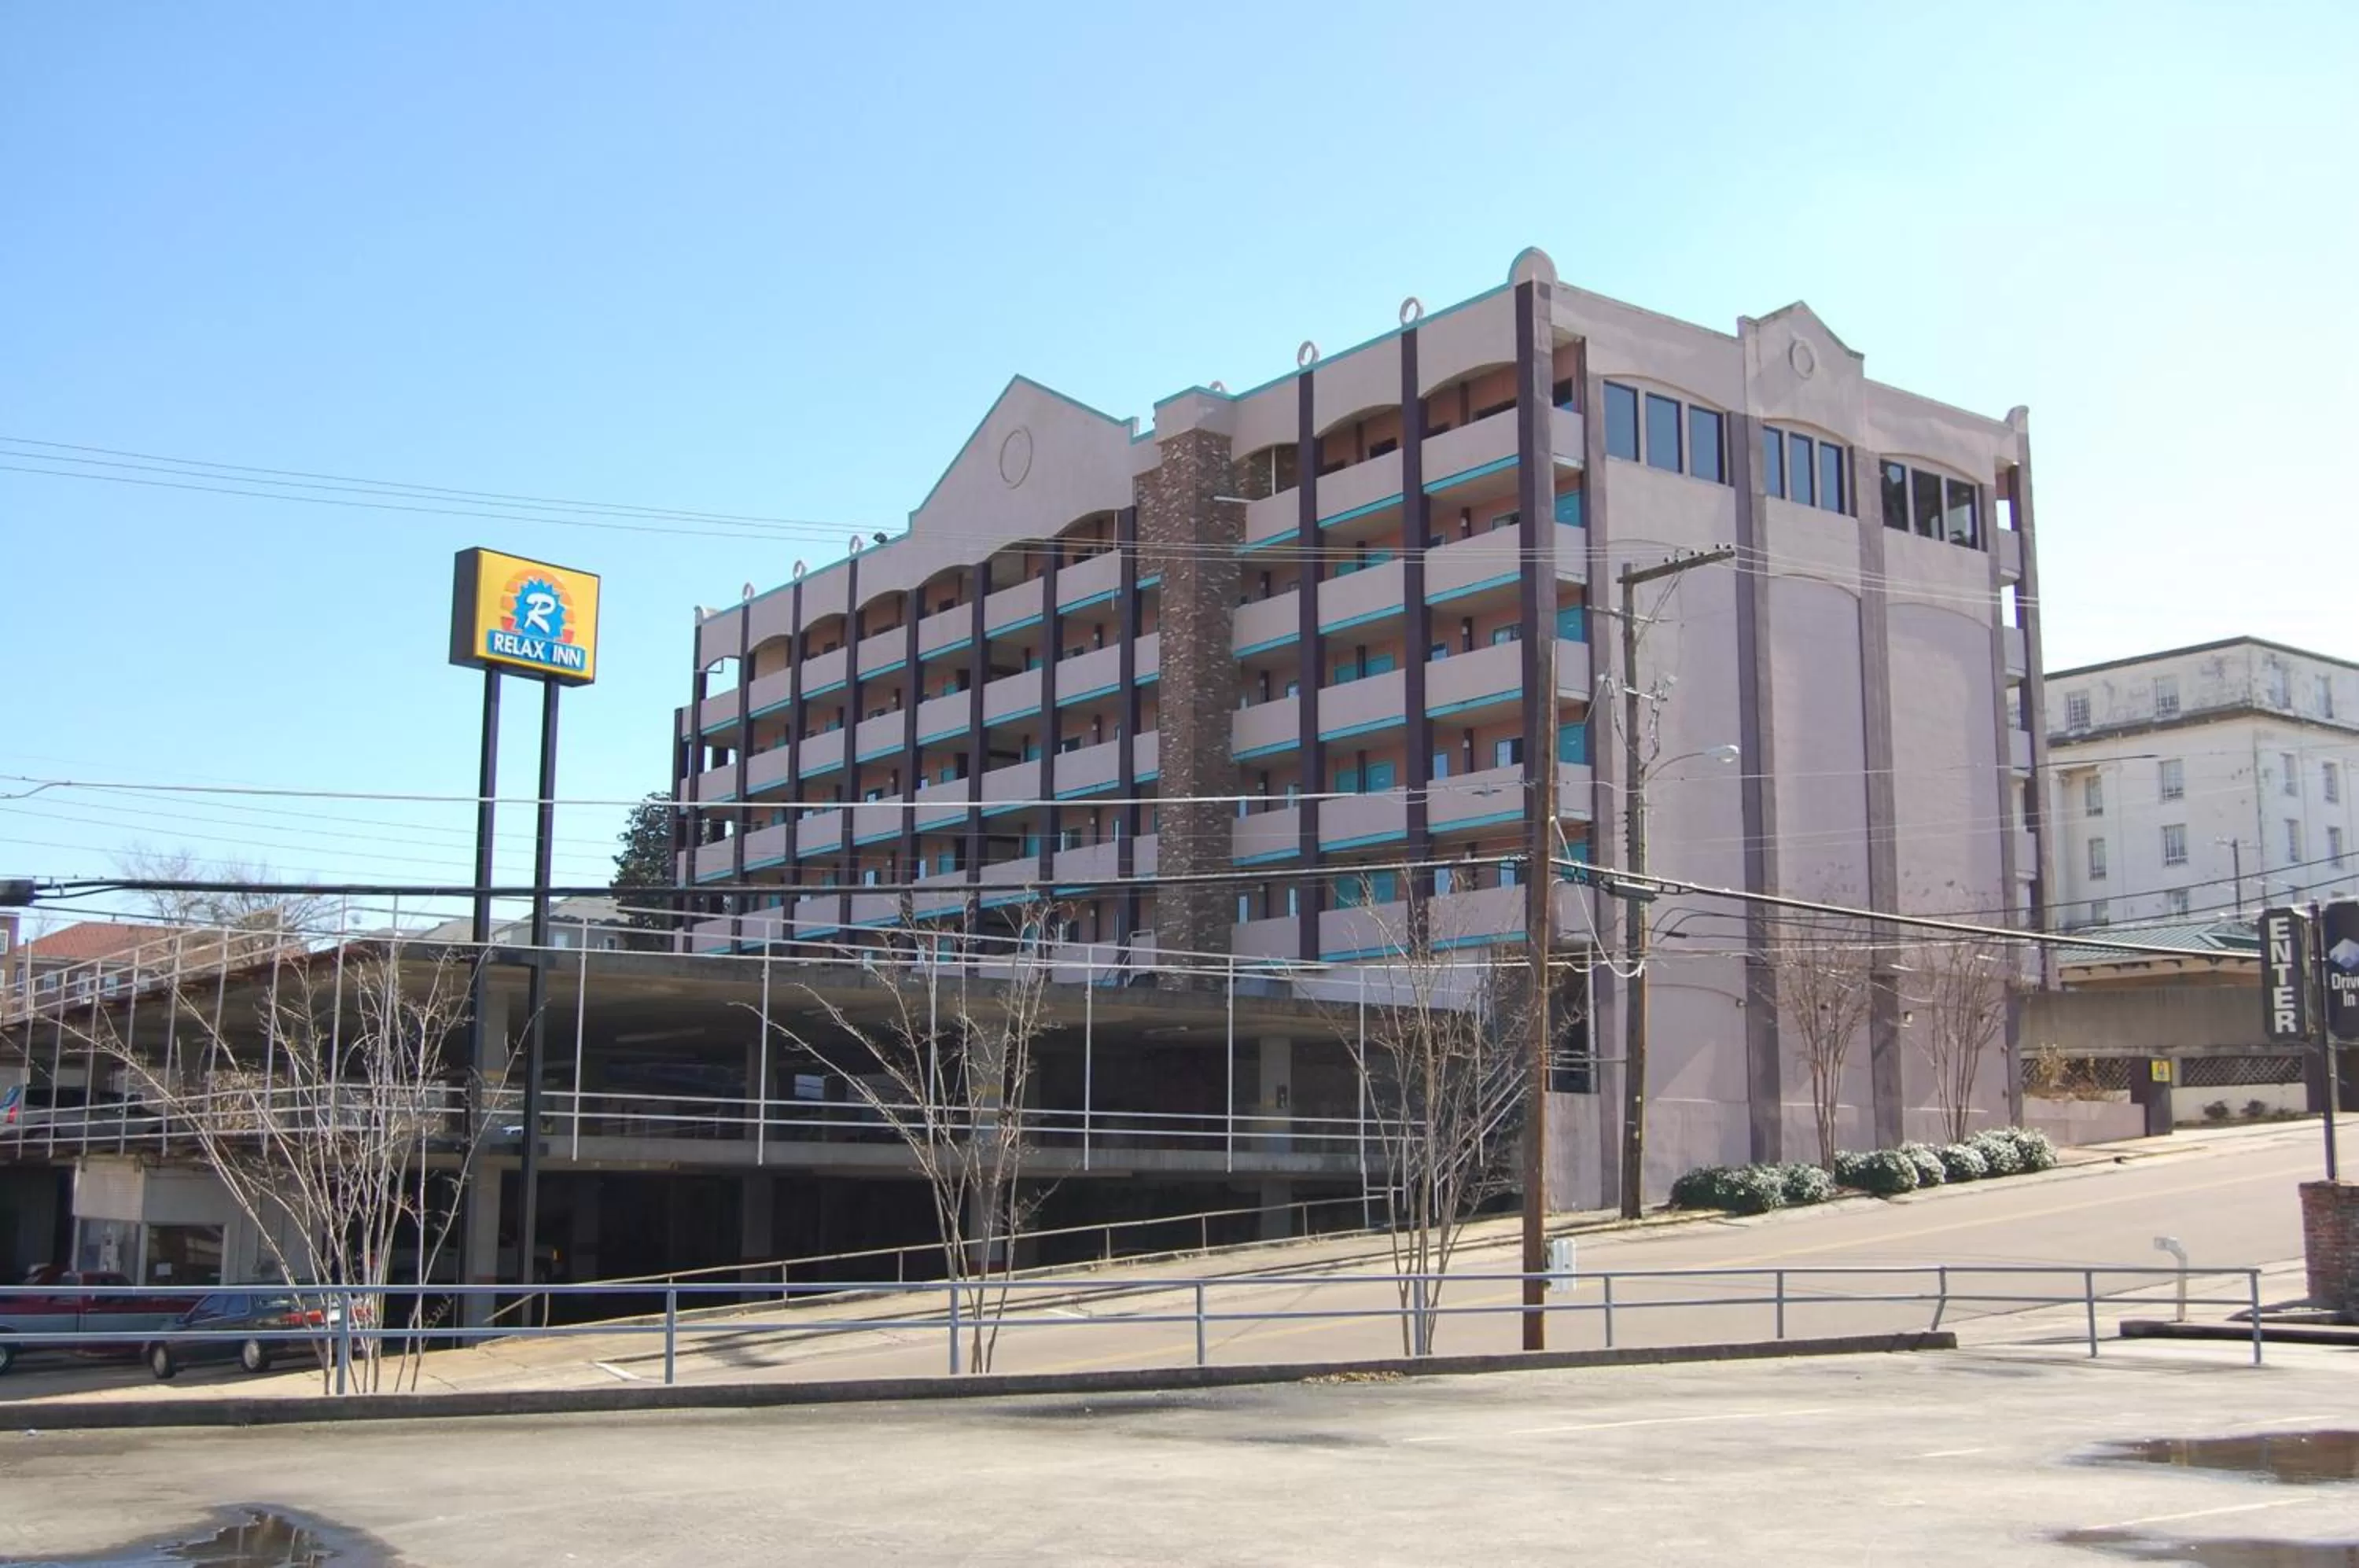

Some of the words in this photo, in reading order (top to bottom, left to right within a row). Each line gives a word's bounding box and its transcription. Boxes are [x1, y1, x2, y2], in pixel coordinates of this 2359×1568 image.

[524, 593, 555, 633] R
[494, 633, 545, 660] RELAX
[552, 647, 580, 667] INN
[2269, 917, 2296, 1033] ENTER
[2331, 972, 2359, 990] Driv
[2343, 990, 2356, 1007] In
